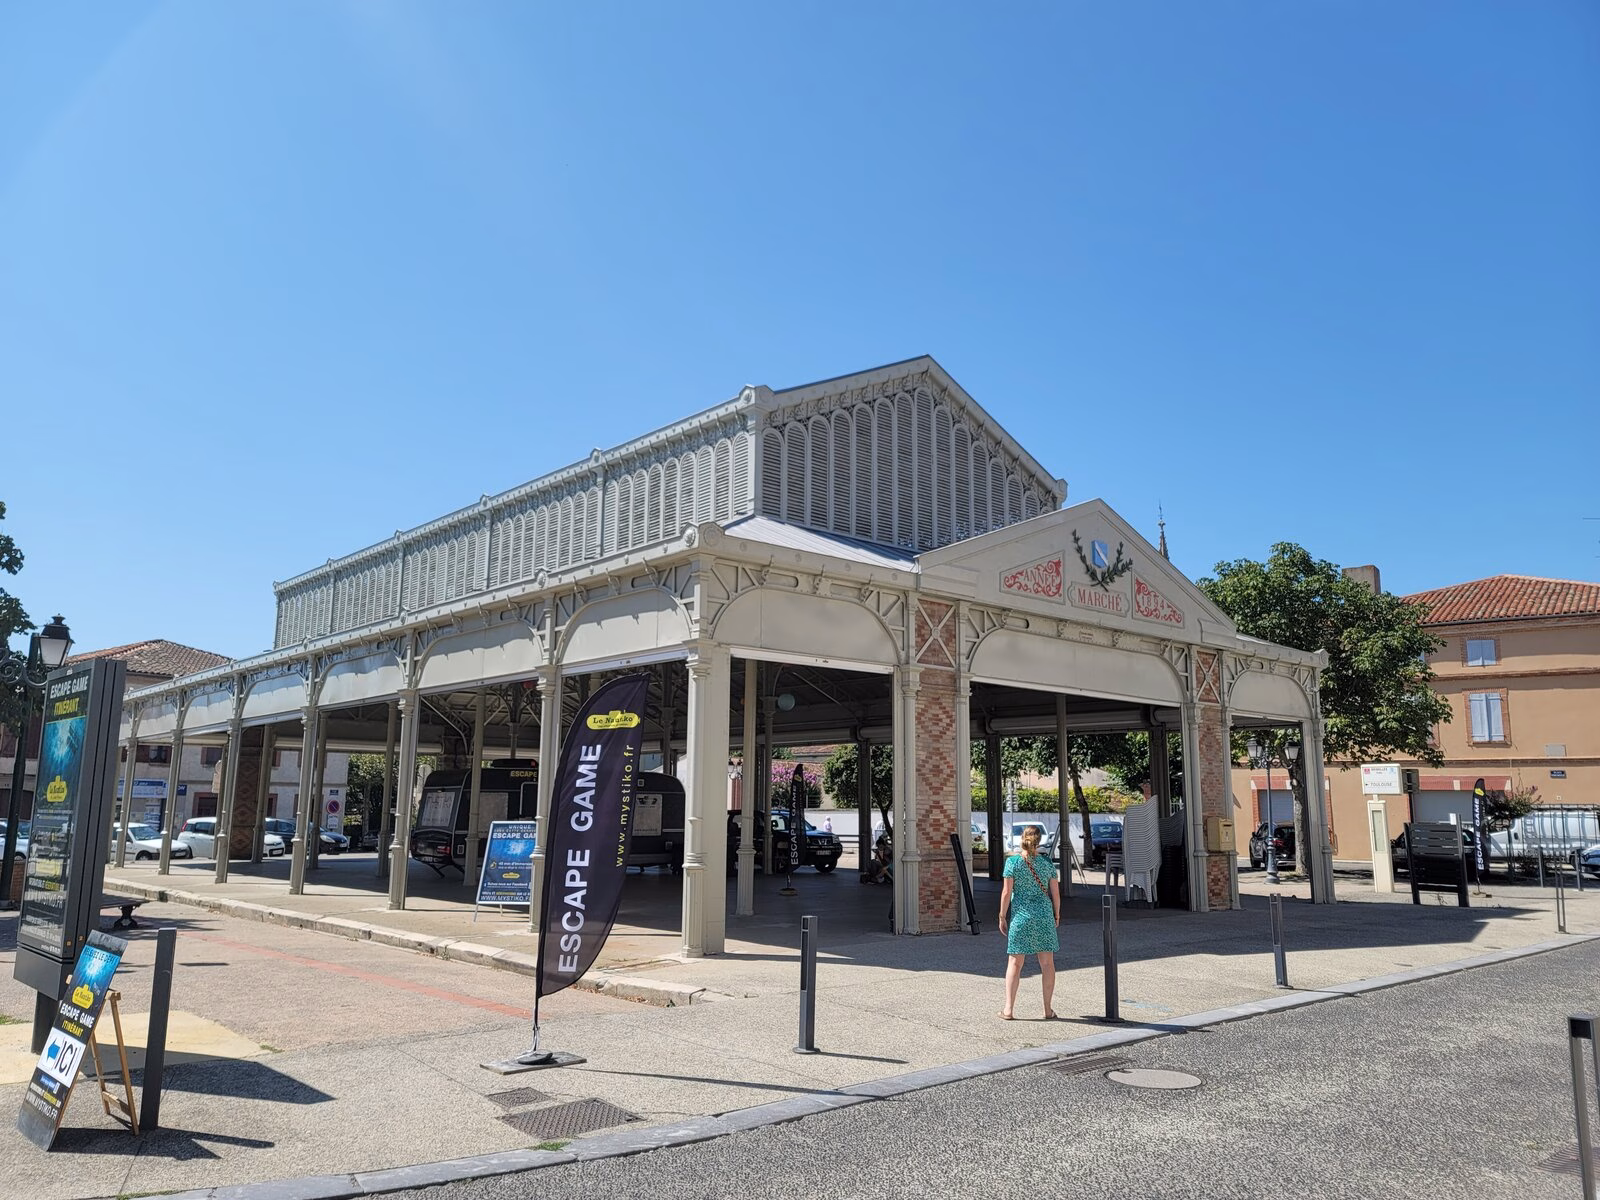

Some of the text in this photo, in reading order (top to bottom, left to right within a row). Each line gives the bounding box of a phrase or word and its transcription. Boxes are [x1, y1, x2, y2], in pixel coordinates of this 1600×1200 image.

[1077, 588, 1122, 612] MARCHÉ
[1141, 595, 1165, 610] 1894
[50, 675, 89, 699] ESCAPE GAME
[510, 770, 537, 778] ESCAPE
[615, 744, 635, 868] www.mystiko.fr
[790, 822, 799, 865] ESCAPE
[1475, 830, 1485, 870] ESCAPE
[557, 744, 602, 973] ESCAPE GAME
[60, 1002, 81, 1021] ESCAPE
[79, 1012, 95, 1029] GAME
[62, 1019, 84, 1037] ITINÉRANT
[54, 1040, 78, 1077] ICI
